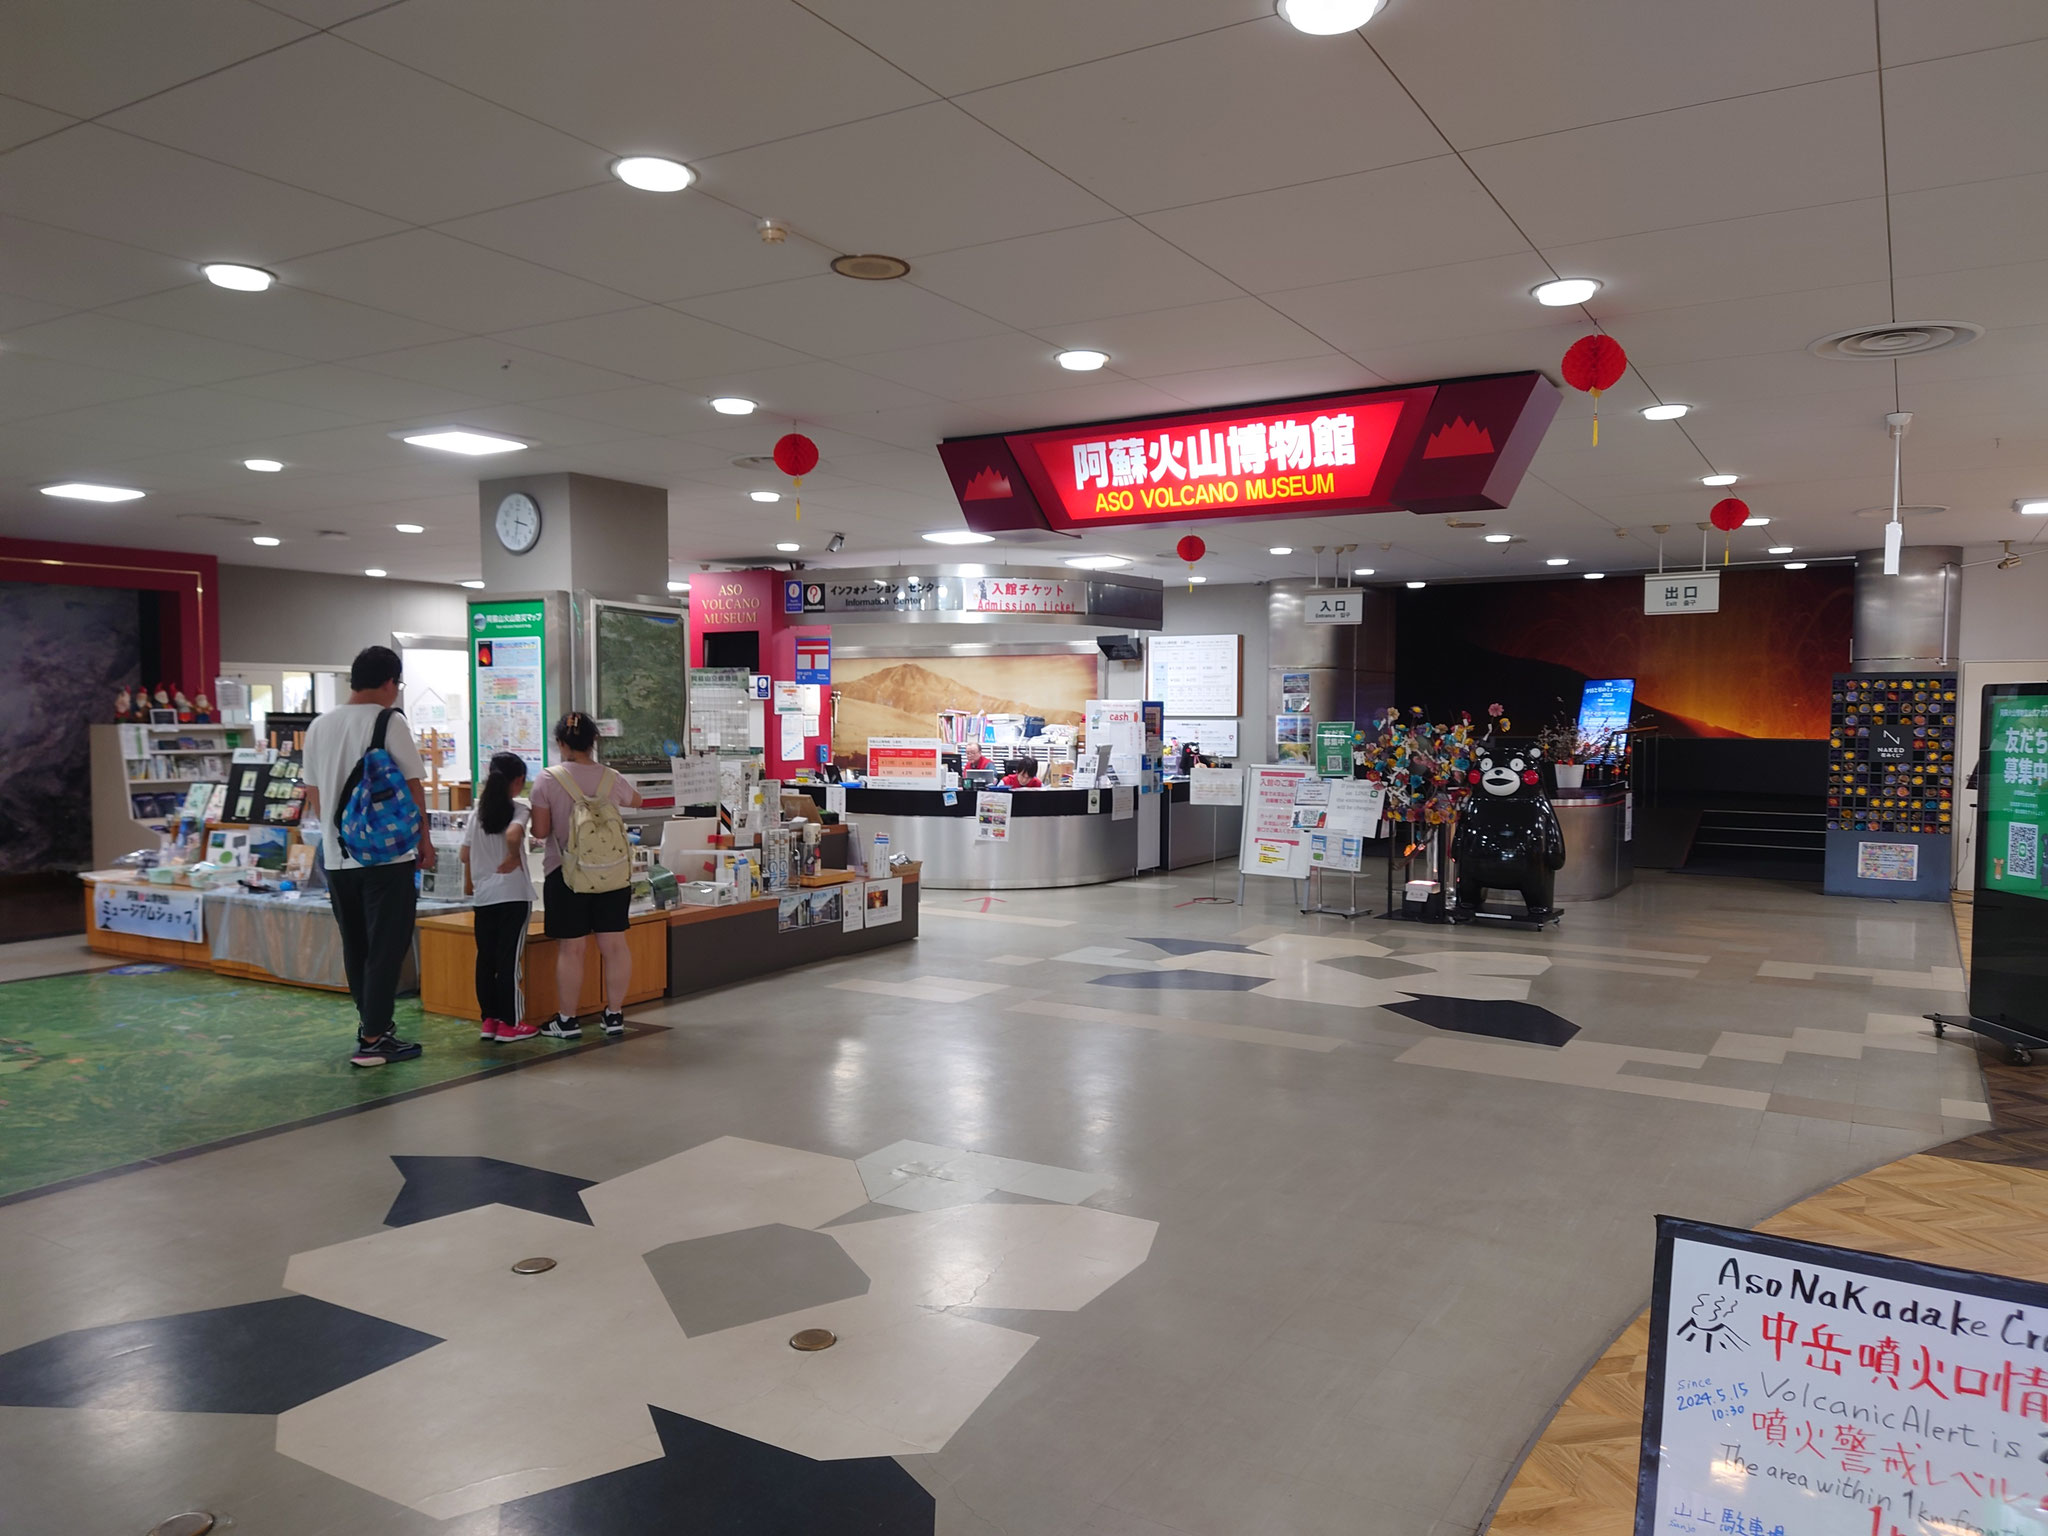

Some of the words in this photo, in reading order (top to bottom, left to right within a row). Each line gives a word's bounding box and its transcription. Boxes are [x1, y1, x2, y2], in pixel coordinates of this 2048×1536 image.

[1072, 412, 1356, 491] 阿蘇火山博物館
[1095, 491, 1135, 513] ASO
[1143, 480, 1239, 510] VOLCANO
[1246, 472, 1335, 499] MUSEUM
[718, 584, 743, 597] ASO
[830, 583, 900, 597] インフォメーション
[991, 582, 1064, 597] 入館チケット
[1665, 586, 1698, 599] 出口
[701, 598, 760, 611] VOLCANO
[977, 598, 1037, 612] Admission
[1043, 600, 1076, 613] ticket
[1320, 600, 1346, 611] 入口
[703, 611, 757, 625] MUSEUM
[1109, 712, 1129, 721] cash
[2005, 727, 2048, 754] 友だち
[2004, 757, 2048, 786] 募集中
[1260, 778, 1296, 788] 入館のご案
[103, 900, 192, 924] ミュージアムショップ
[1718, 1257, 1783, 1299] Aso
[1711, 1404, 1745, 1422] 10:30
[1991, 1430, 2022, 1459] is
[1752, 1407, 2032, 1503] 噴火警戒レベル
[1720, 1442, 1759, 1477] The
[1766, 1465, 1809, 1490] area
[1816, 1475, 1892, 1511] within
